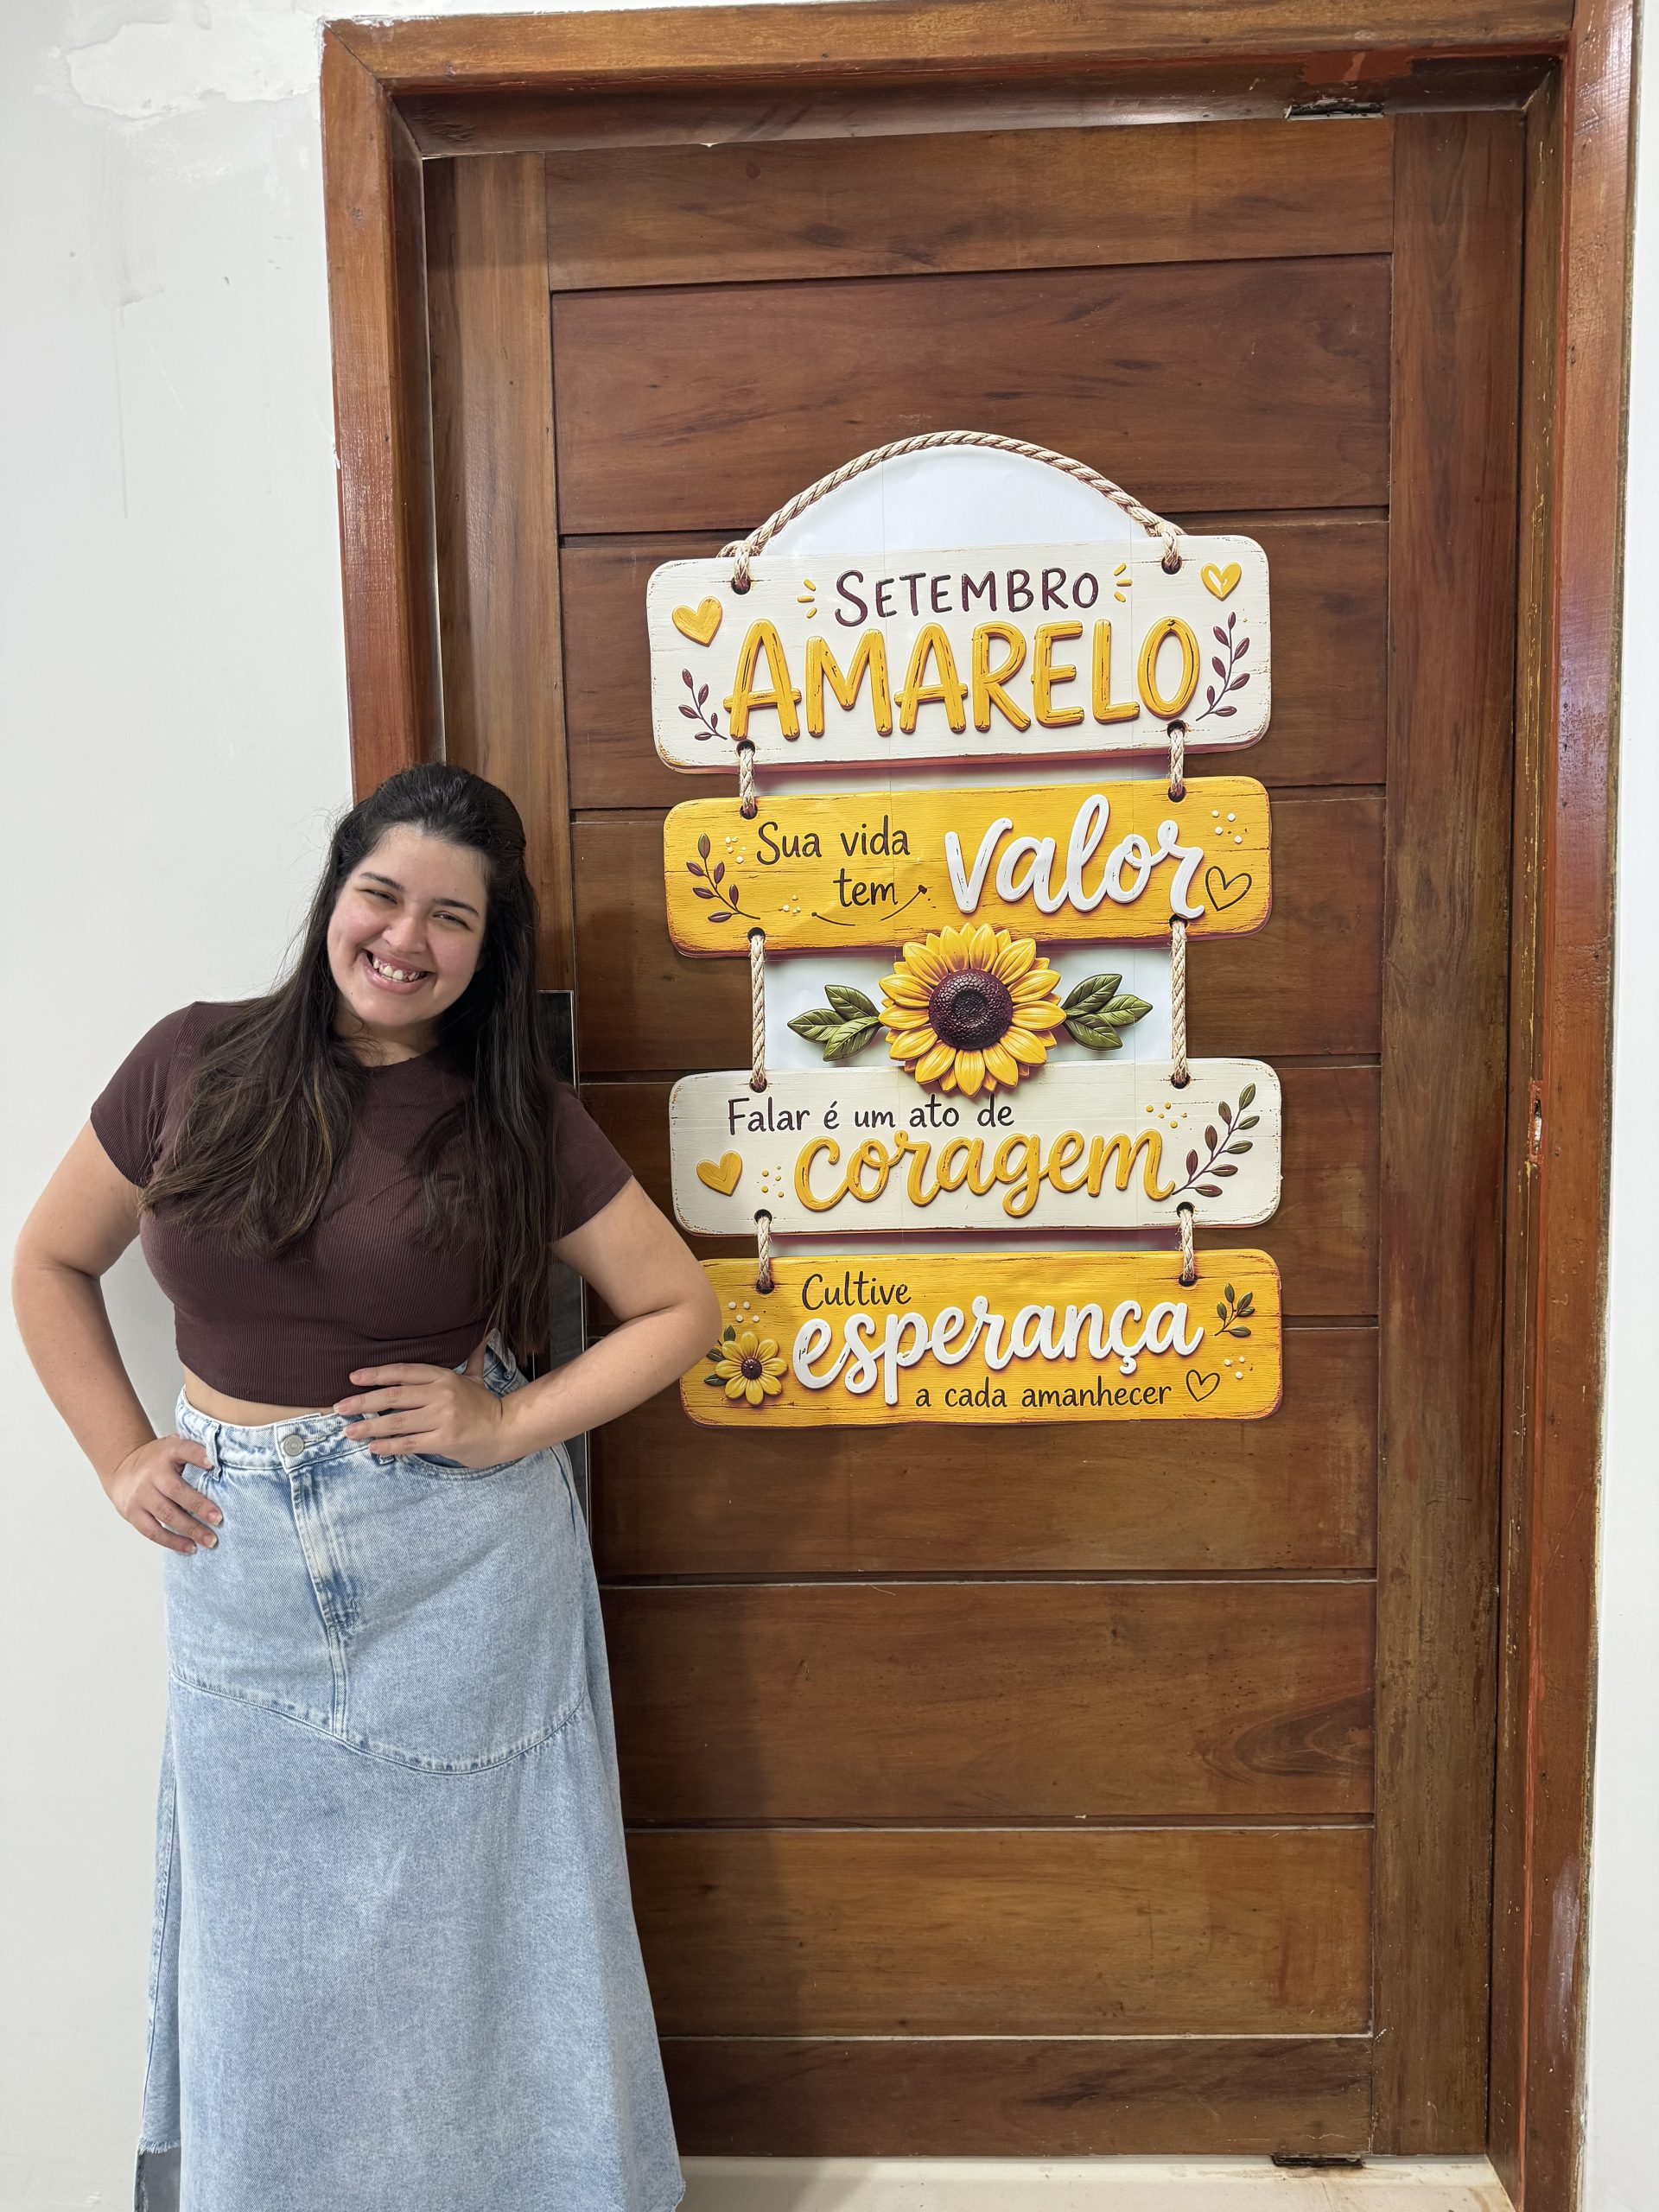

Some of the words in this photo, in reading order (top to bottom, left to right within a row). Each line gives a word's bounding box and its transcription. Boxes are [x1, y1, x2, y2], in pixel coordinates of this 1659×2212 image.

[723, 616, 1201, 741] AMARELO
[757, 822, 821, 865] Sua
[840, 815, 910, 856] vida
[832, 868, 898, 907] tem
[728, 1097, 810, 1135] Falar
[823, 1101, 838, 1130] é
[855, 1109, 895, 1128] um
[909, 1094, 960, 1128] ato
[977, 1096, 1015, 1126] de
[794, 1128, 1176, 1218] coragem
[801, 1271, 912, 1310] Cultive
[791, 1295, 1205, 1406] esperança
[916, 1388, 931, 1407] a
[944, 1377, 1007, 1408] cada
[1021, 1376, 1172, 1407] amanhecer
